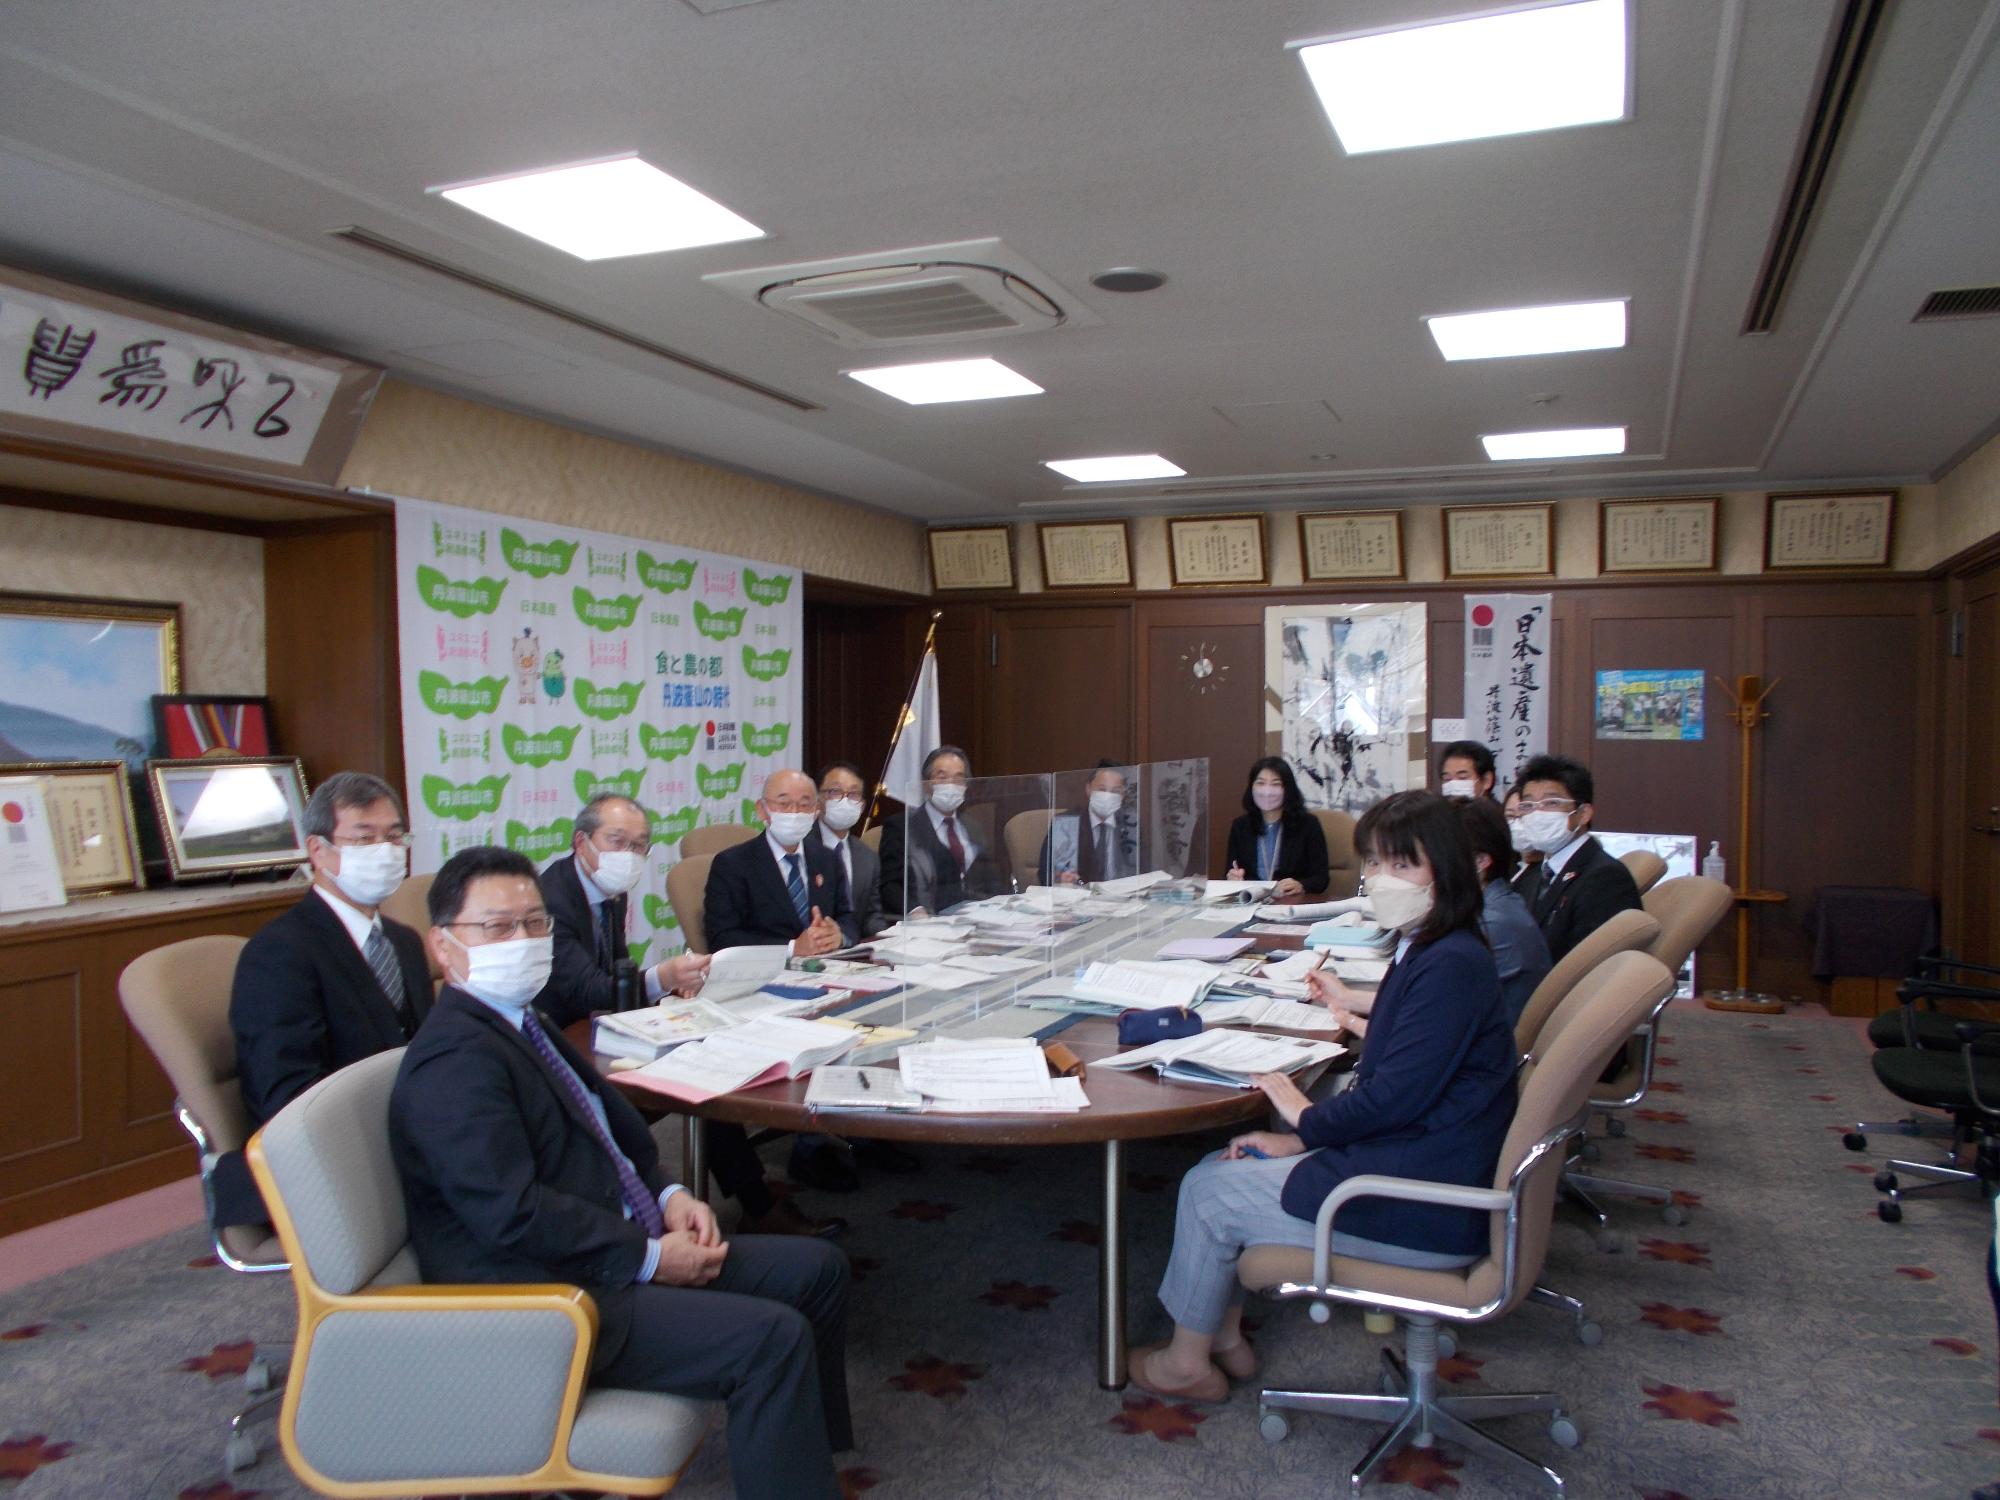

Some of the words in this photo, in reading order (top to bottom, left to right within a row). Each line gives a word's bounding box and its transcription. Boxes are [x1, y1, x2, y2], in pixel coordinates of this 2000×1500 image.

[432, 584, 490, 605] 丹波篠山市
[656, 650, 723, 678] 食と農の都
[434, 688, 492, 705] 丹波篠山市
[437, 790, 494, 807] 丹波篠山市
